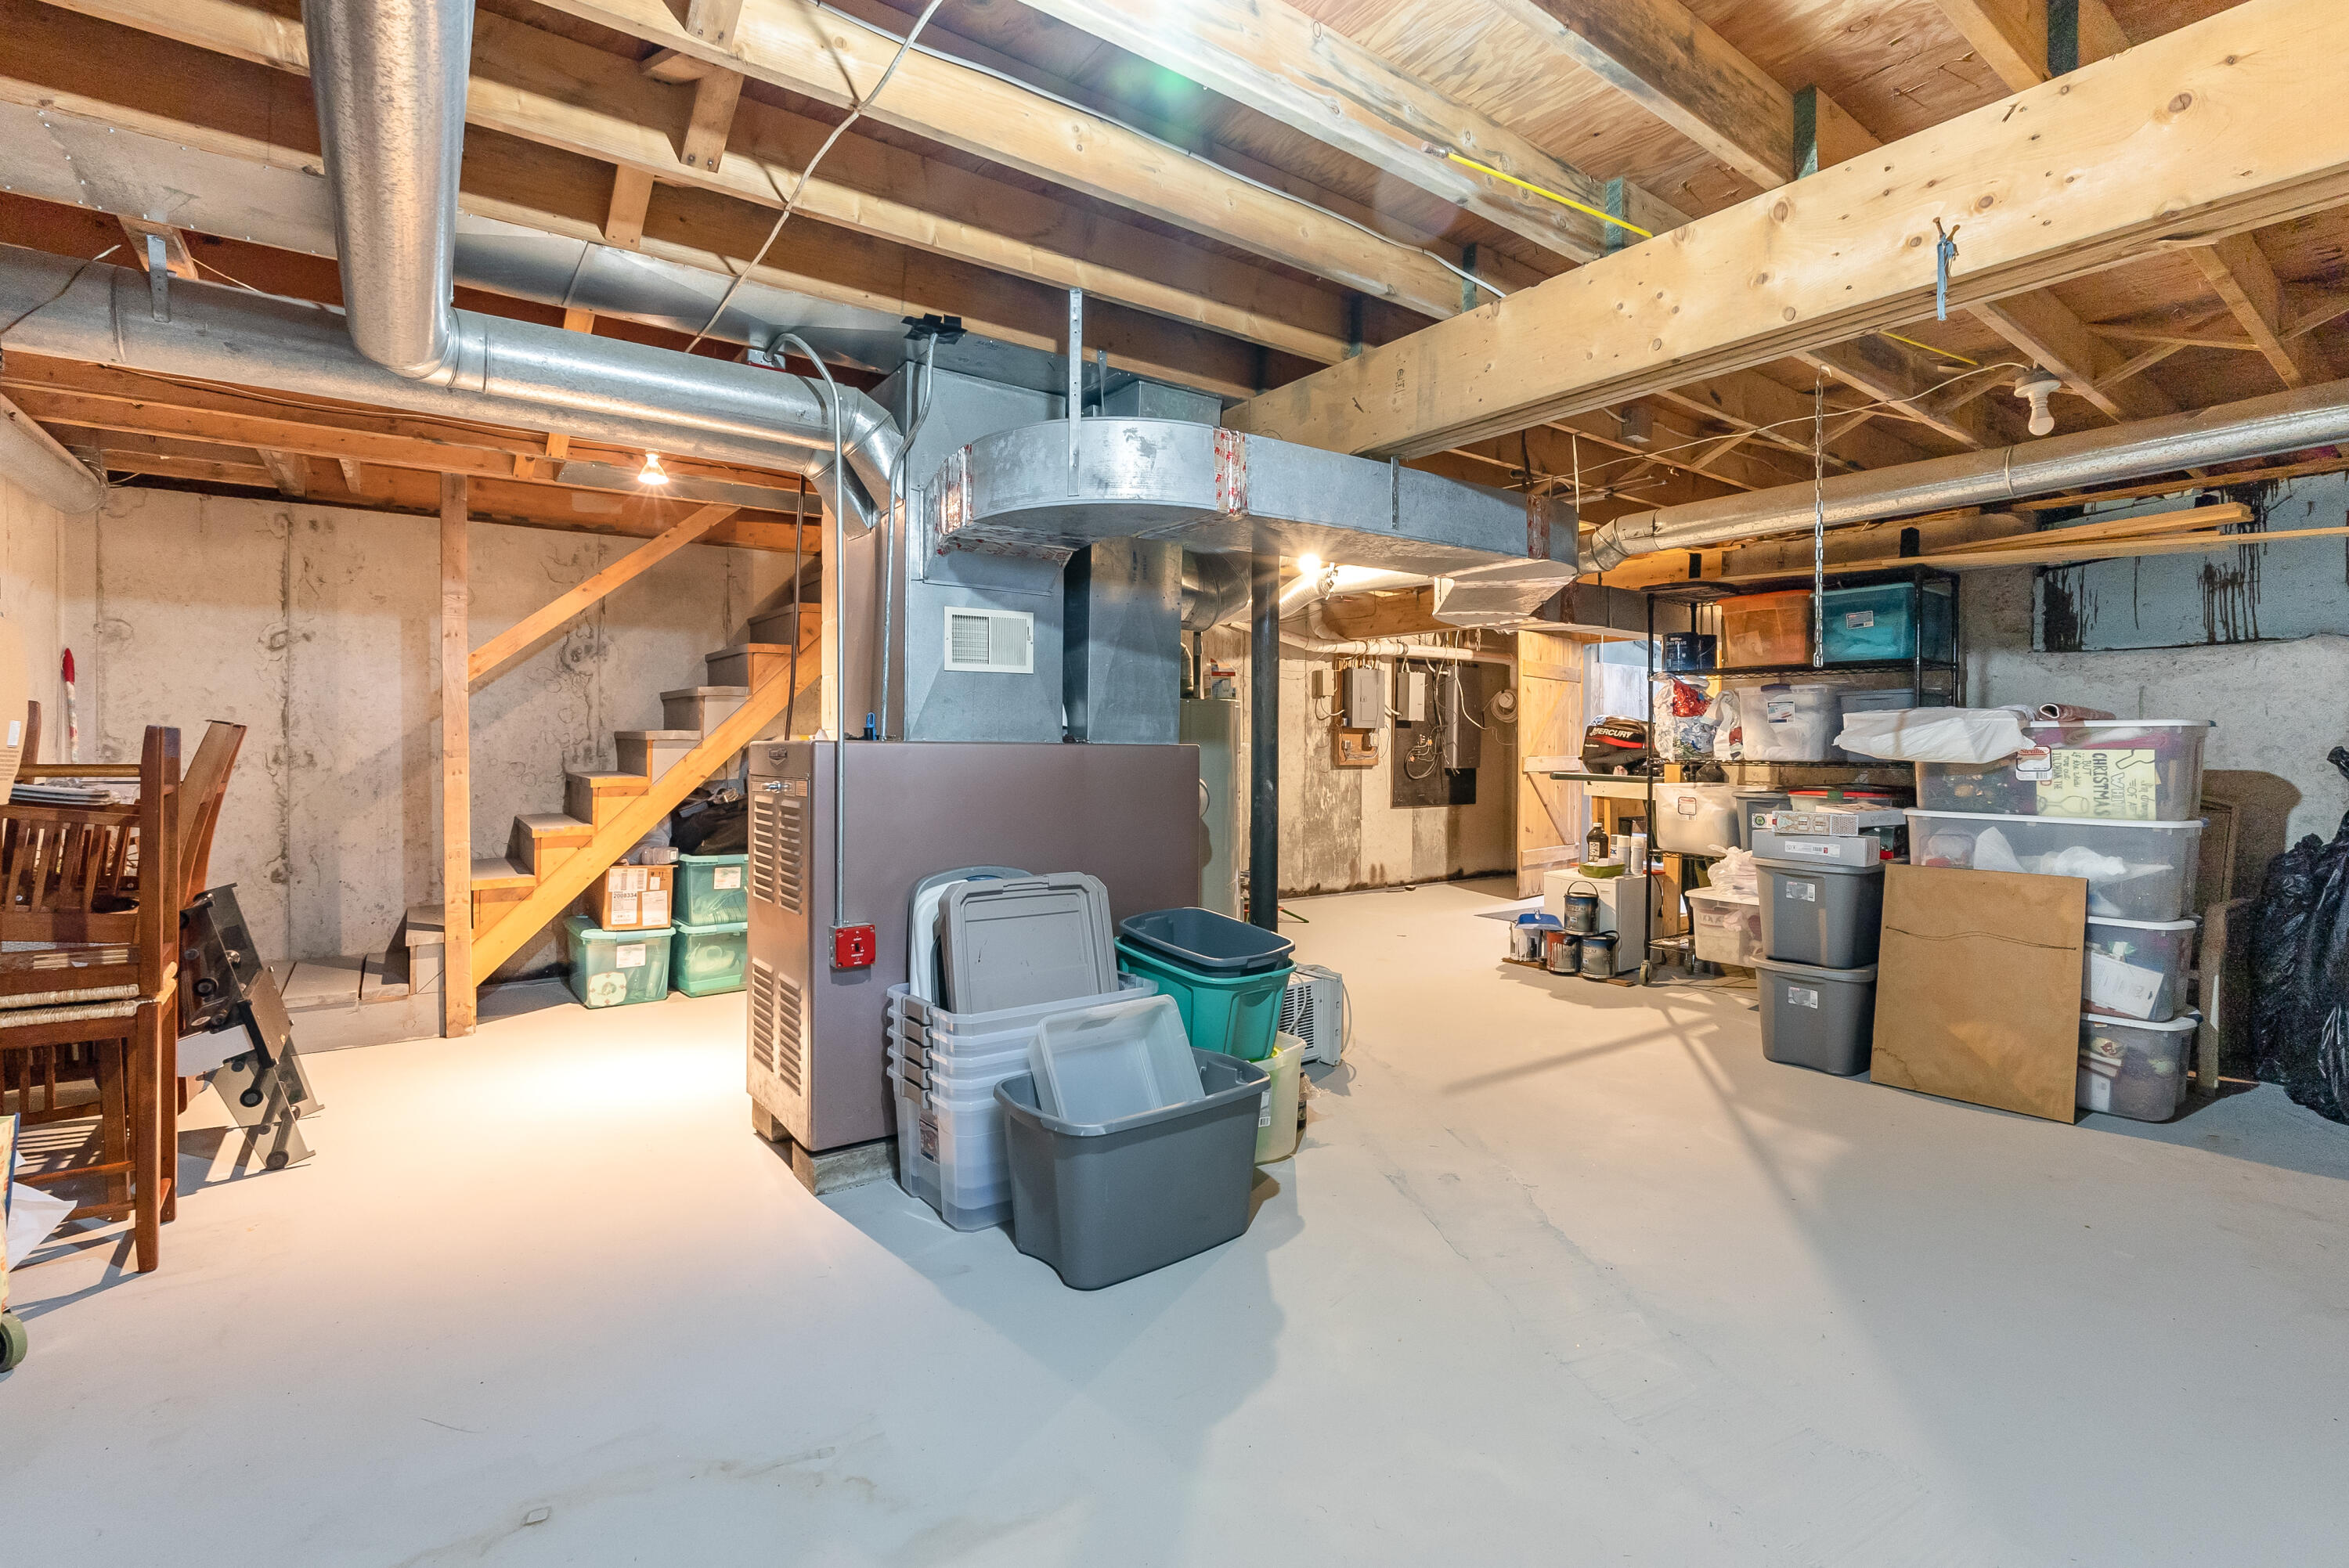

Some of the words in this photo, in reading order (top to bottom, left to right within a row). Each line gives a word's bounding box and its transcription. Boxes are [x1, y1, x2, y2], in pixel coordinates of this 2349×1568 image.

[1590, 727, 1633, 738] MERCURY
[2053, 781, 2062, 790] THE
[2091, 752, 2110, 816] CHRISTMAS
[2127, 787, 2137, 798] OF
